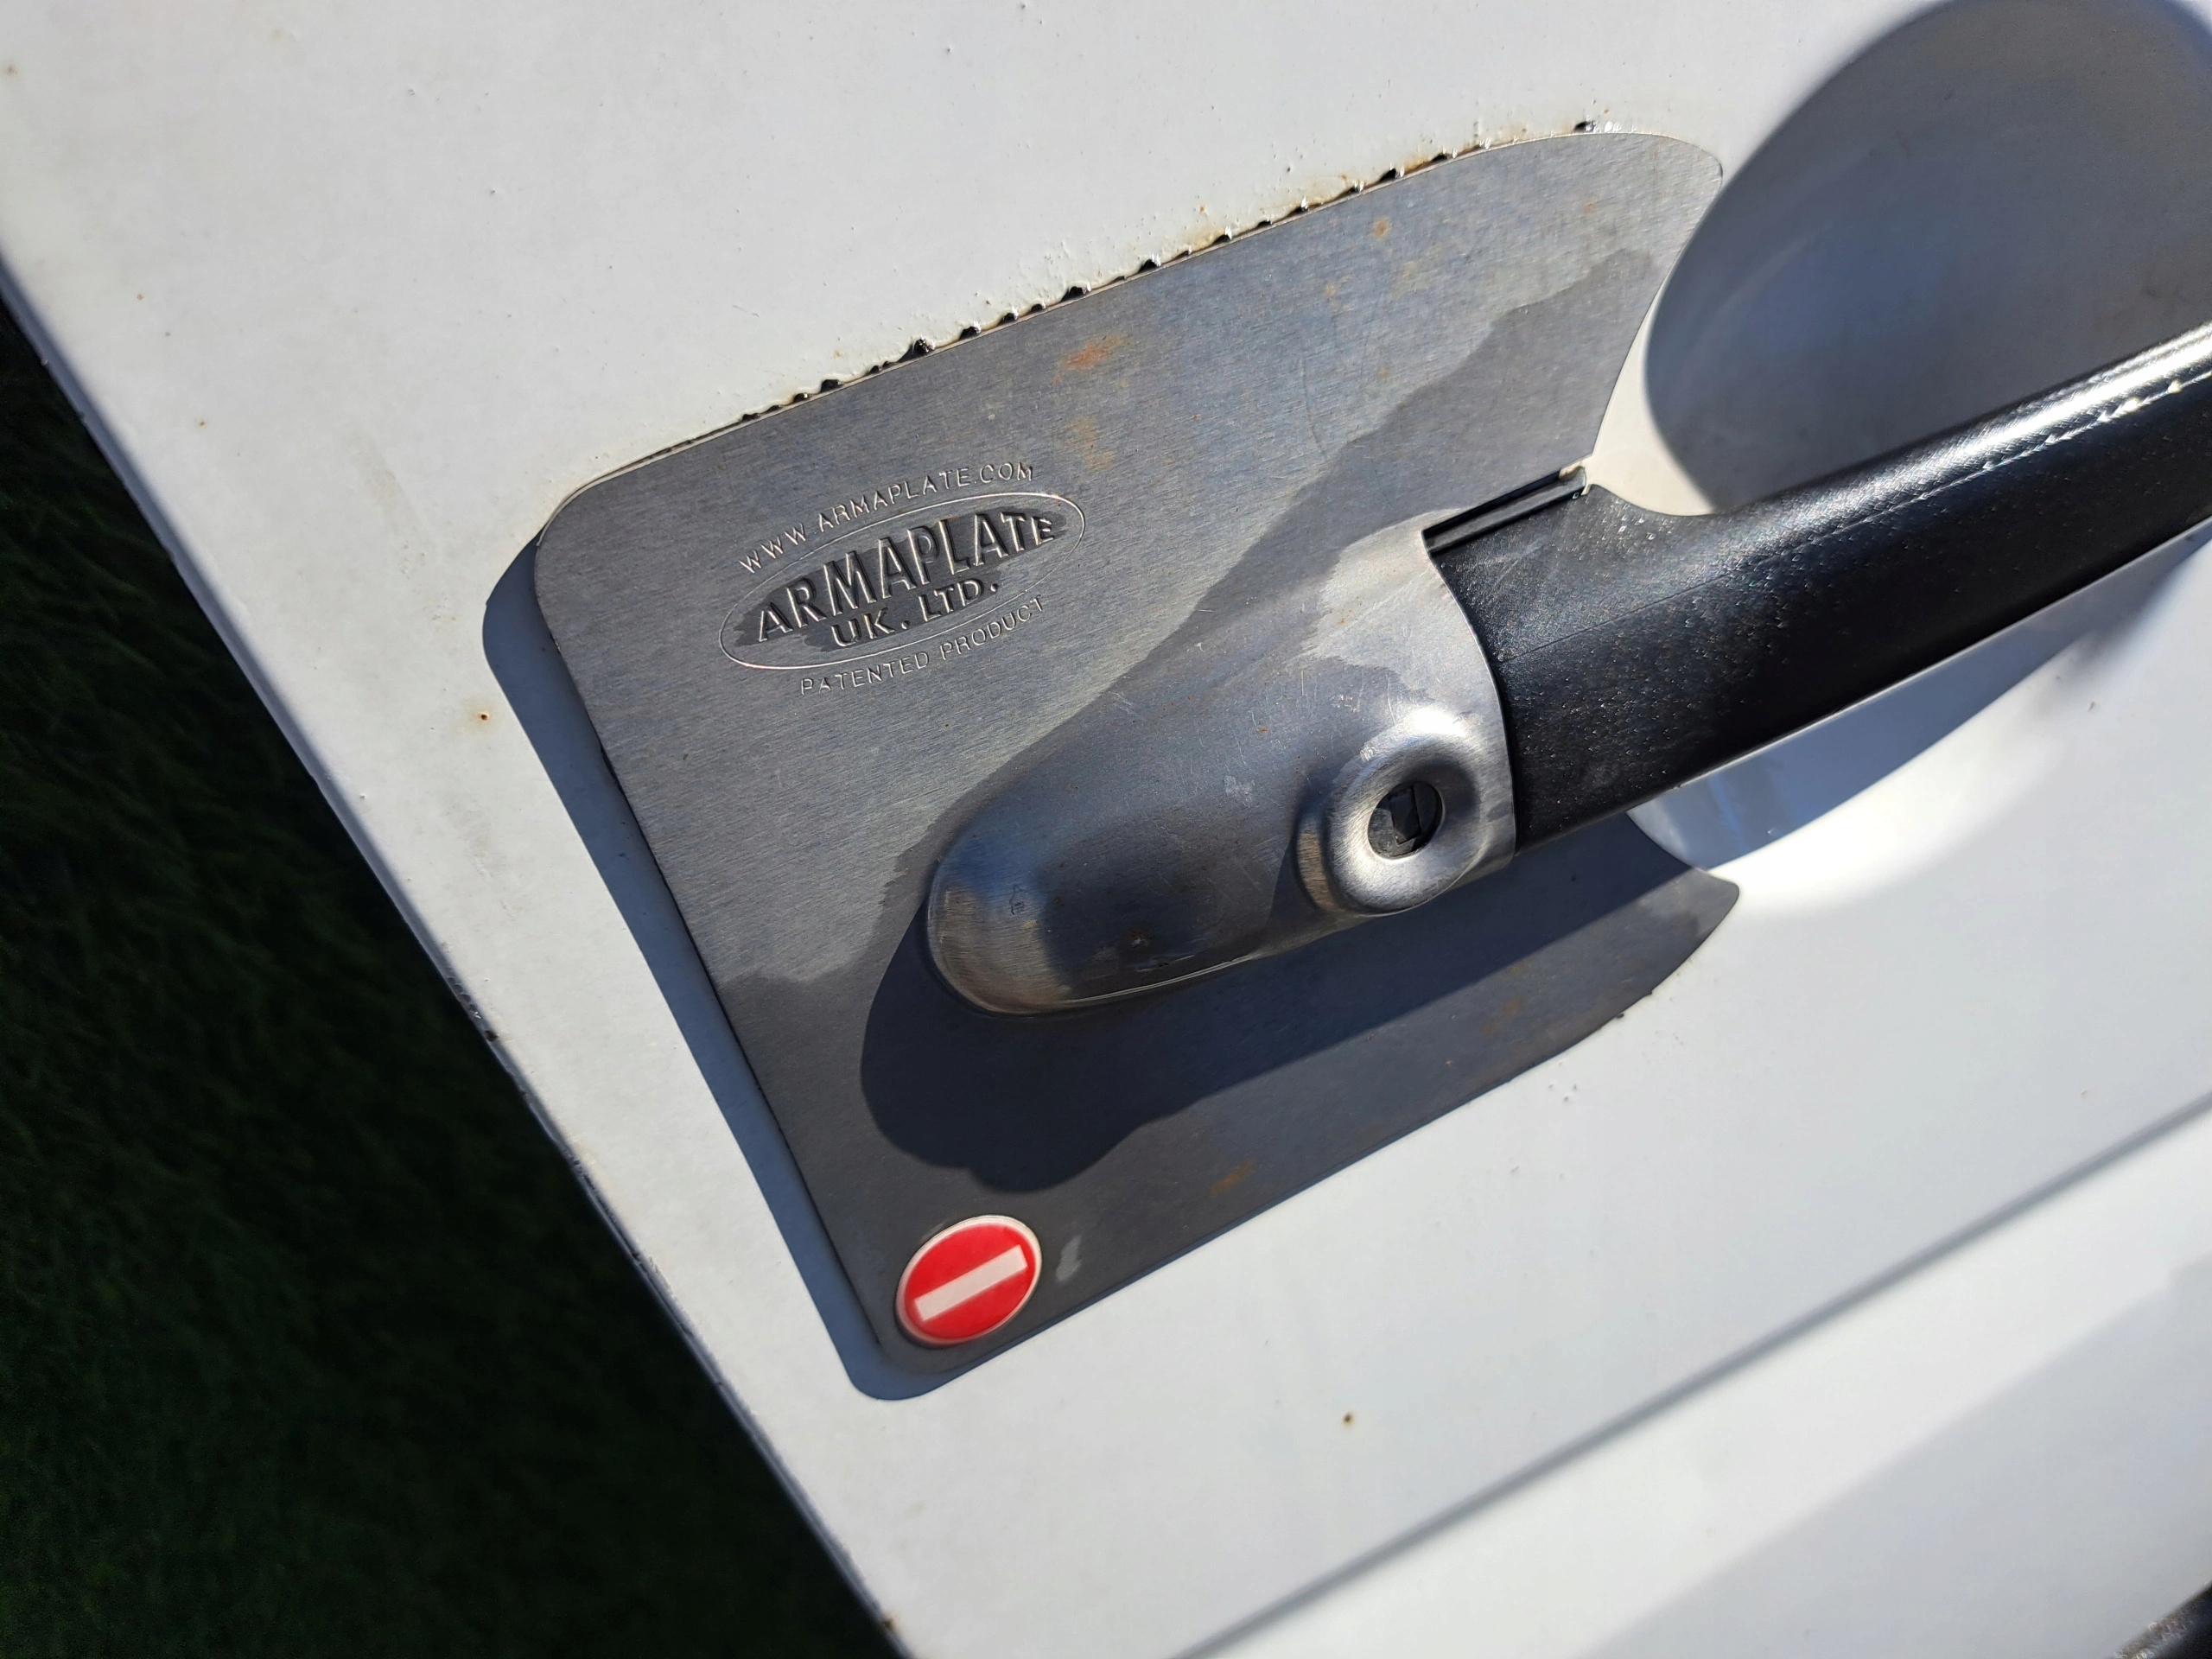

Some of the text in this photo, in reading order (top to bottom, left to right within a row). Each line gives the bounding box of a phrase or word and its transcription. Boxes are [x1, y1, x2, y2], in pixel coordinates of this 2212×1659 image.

[755, 511, 1056, 643] ARMAPLATE
[830, 577, 1000, 648] UK. LTD.
[800, 594, 1044, 696] PATENTED PRODUCT
